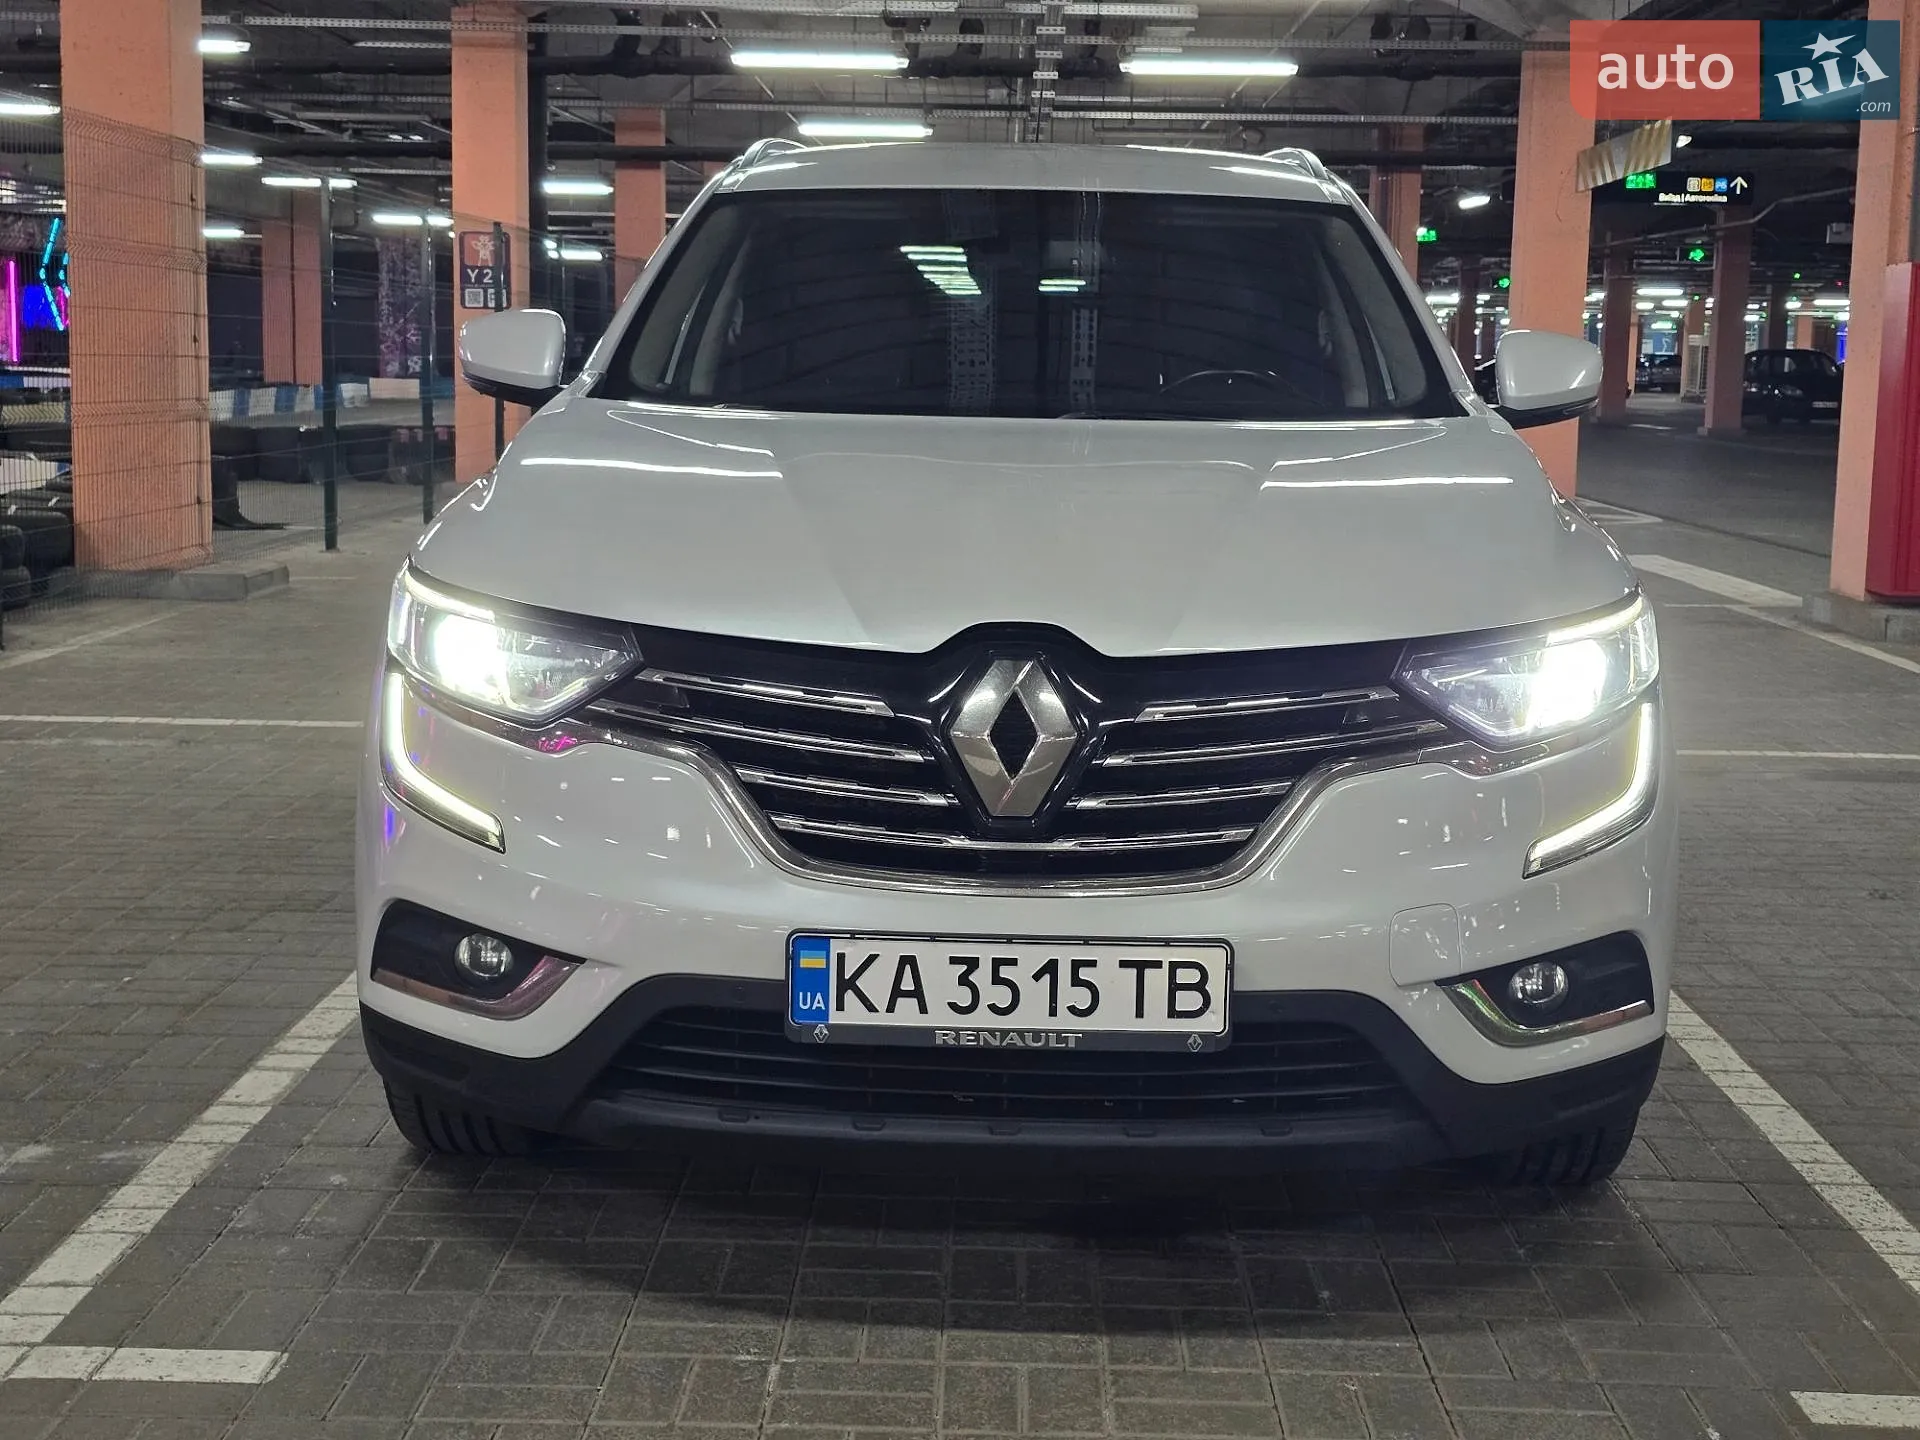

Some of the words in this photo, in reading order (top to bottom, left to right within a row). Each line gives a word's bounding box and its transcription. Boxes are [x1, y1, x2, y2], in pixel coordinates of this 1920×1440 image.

[835, 952, 929, 1014] KA
[947, 956, 1101, 1018] 3515
[1118, 959, 1212, 1019] TB
[799, 991, 826, 1011] UA
[934, 1029, 1083, 1049] RENAULT
